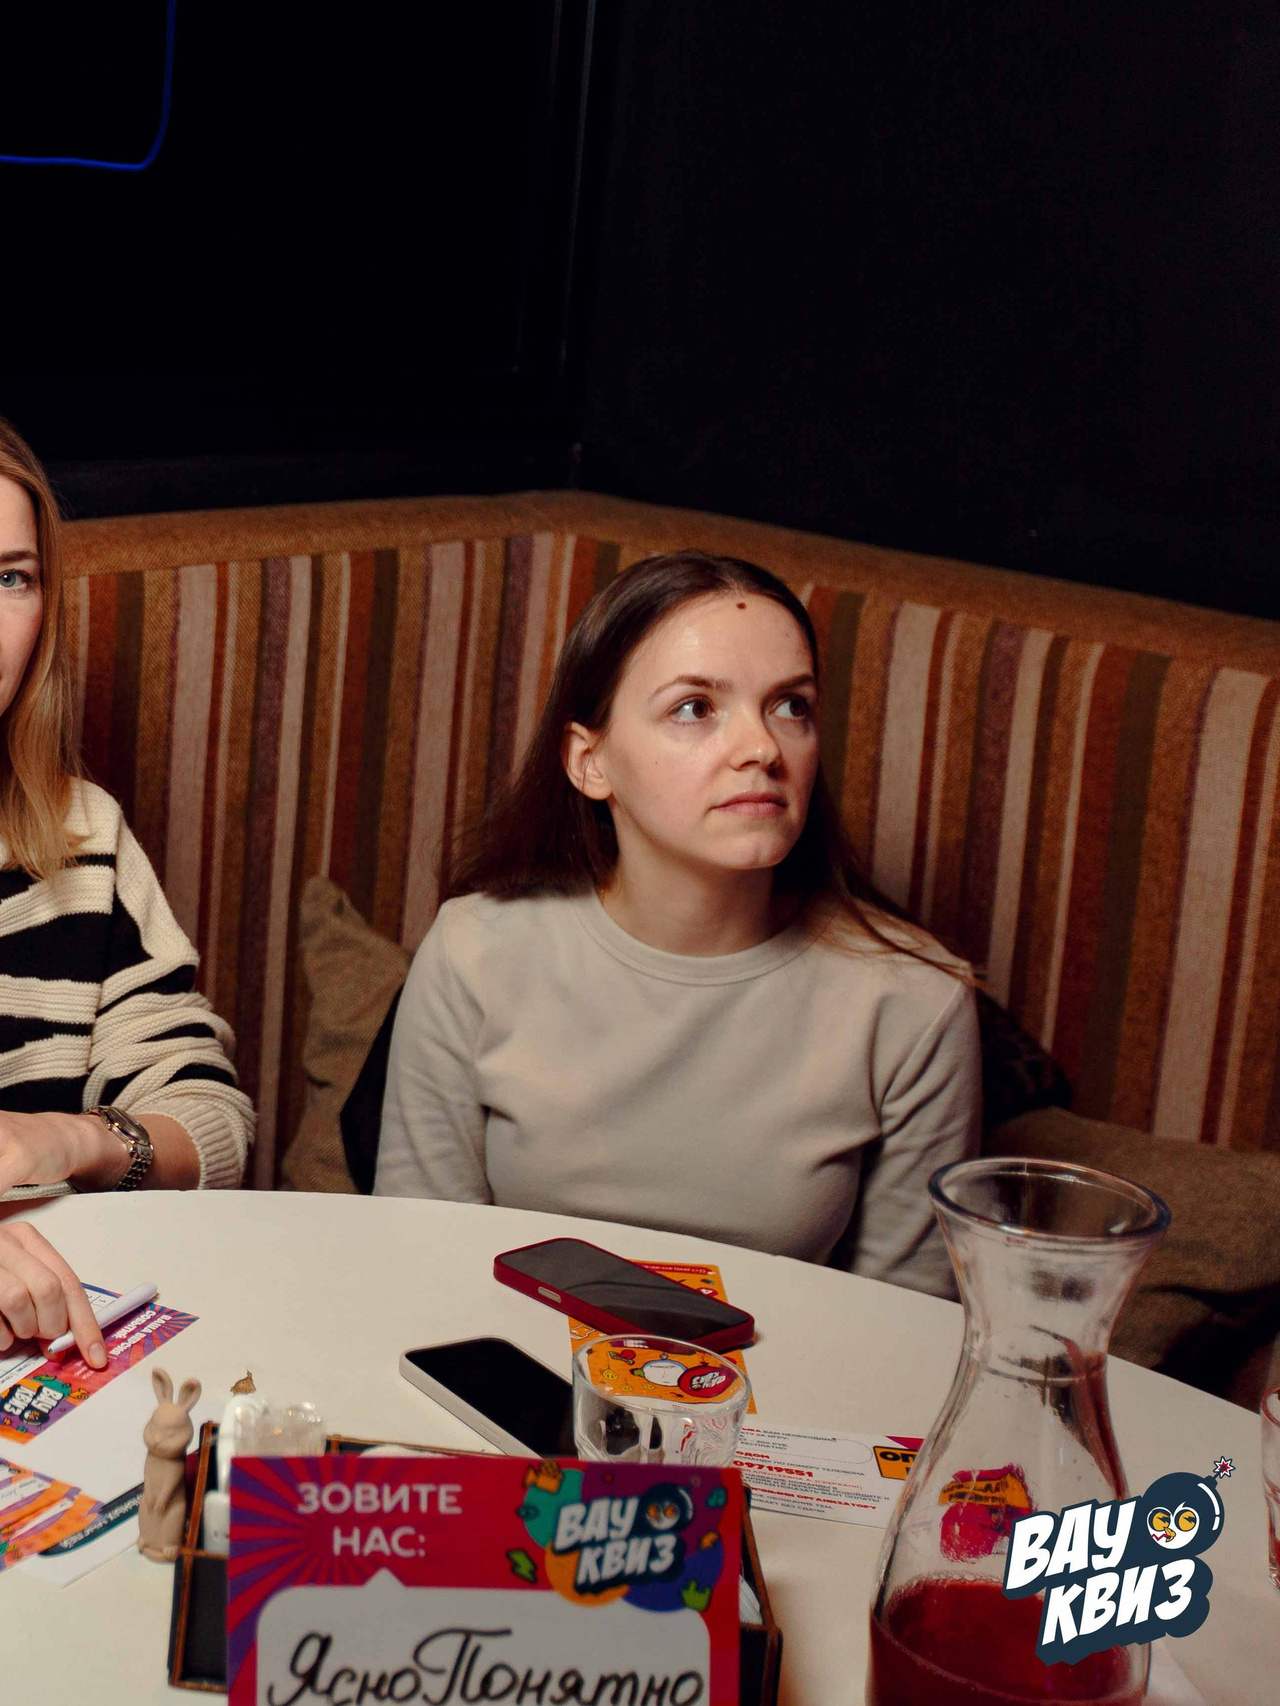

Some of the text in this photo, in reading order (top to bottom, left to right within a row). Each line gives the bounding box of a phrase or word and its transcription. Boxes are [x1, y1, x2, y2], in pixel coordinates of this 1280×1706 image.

[3, 1385, 37, 1416] КВИЗ
[30, 1386, 64, 1414] ВАУ
[297, 1483, 463, 1515] ЗОВИТЕ
[554, 1496, 639, 1549] ВАУ
[332, 1526, 426, 1558] НАС:
[576, 1535, 675, 1584] КВИЗ
